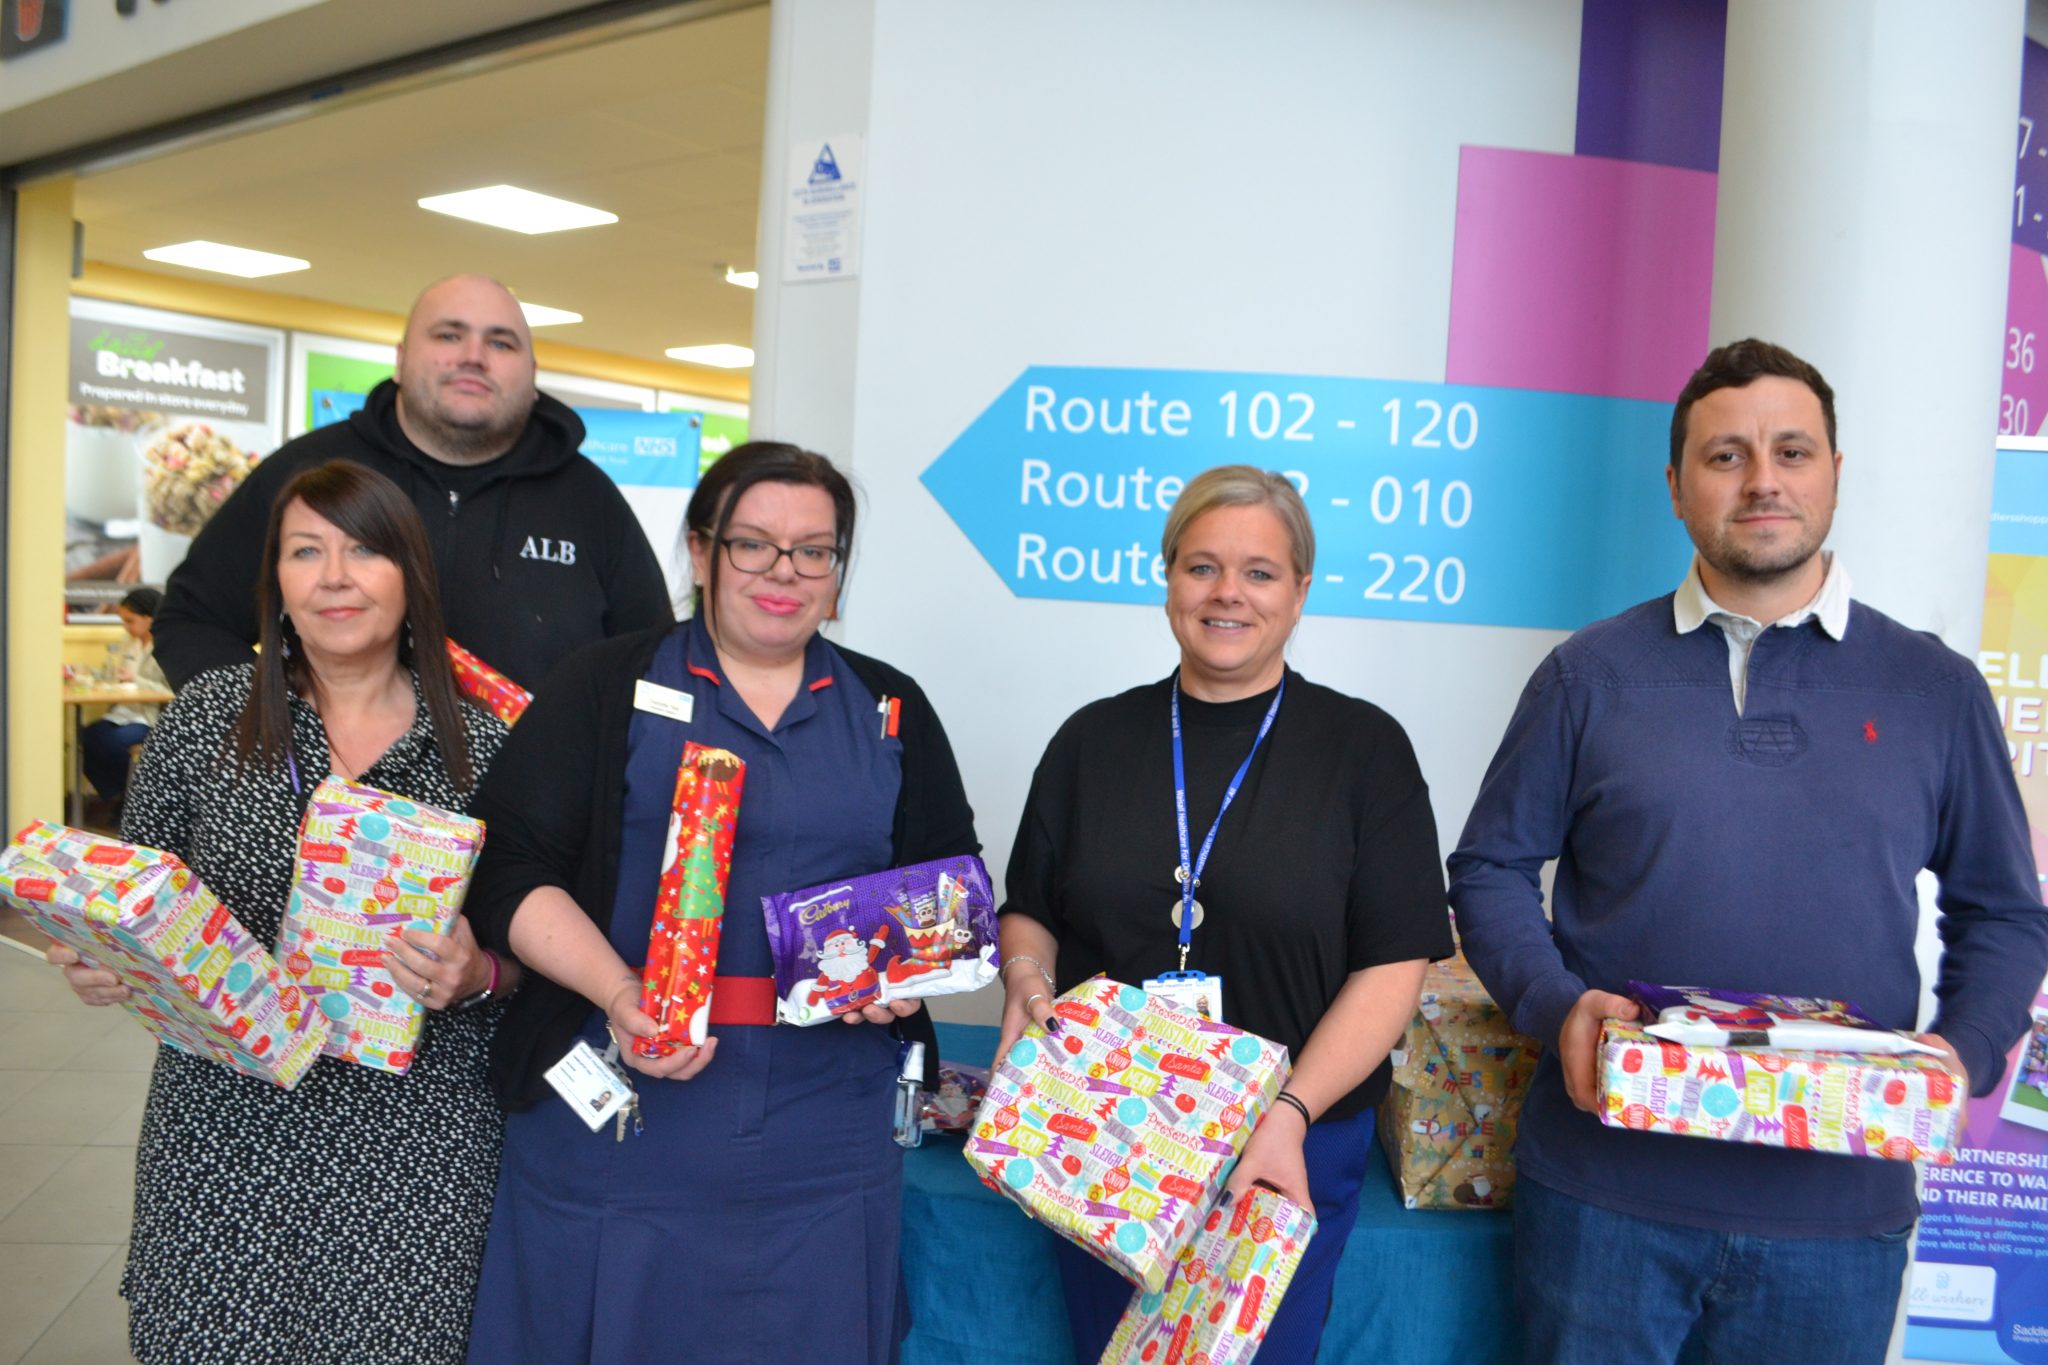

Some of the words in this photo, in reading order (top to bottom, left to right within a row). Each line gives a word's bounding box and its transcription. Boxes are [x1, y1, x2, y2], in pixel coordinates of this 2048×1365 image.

[2006, 327, 2036, 374] 36
[96, 350, 246, 394] Breakfast
[1025, 385, 1192, 436] Route
[1218, 390, 1315, 441] 102
[1382, 398, 1479, 450] 120
[1999, 394, 2029, 436] 30
[635, 437, 676, 457] NHS
[1020, 459, 1184, 511] Route
[1369, 475, 1473, 529] 010
[519, 535, 576, 565] ALB
[1363, 552, 1467, 605] 220
[1174, 789, 1185, 811] Walsall
[389, 822, 456, 851] Presents
[1176, 812, 1189, 848] Healthcare
[394, 838, 470, 873] CHRISTMAS
[1180, 848, 1189, 860] For
[374, 884, 398, 900] SNOW
[151, 888, 218, 959] CHRISTMAS
[299, 898, 366, 926] Presents
[799, 898, 850, 926] Cadbury
[306, 914, 383, 947] CHRISTMAS
[197, 947, 234, 986] MERRY
[252, 989, 281, 1025] SLEIGH
[279, 987, 299, 1010] SNOW
[1058, 1000, 1093, 1026] Santa
[1145, 996, 1199, 1031] Presents
[1091, 1025, 1125, 1050] SLEIGH
[1142, 1013, 1208, 1054] CHRISTMAS
[1032, 1052, 1090, 1092] Presents
[1106, 1051, 1130, 1070] SNOW
[1164, 1051, 1205, 1082] Santa
[1217, 1058, 1251, 1083] NOEL
[1029, 1070, 1098, 1116] CHRISTMAS
[1123, 1068, 1158, 1096] MERRY
[1203, 1080, 1238, 1106] SLEIGH
[1647, 1075, 1668, 1115] SLEIGH
[994, 1109, 1017, 1128] SNOW
[1054, 1114, 1091, 1141] Santa
[1142, 1109, 1205, 1152] Presents
[1219, 1108, 1245, 1129] SNOW
[1629, 1105, 1645, 1129] SNOW
[1011, 1127, 1045, 1155] MERRY
[1088, 1142, 1123, 1168] SLEIGH
[1140, 1130, 1213, 1177] CHRISTMAS
[1028, 1171, 1090, 1214] Presents
[1103, 1169, 1130, 1191] SNOW
[1989, 1171, 2013, 1187] TO
[2018, 1174, 2048, 1189] WA
[1123, 1189, 1156, 1216] MERRY
[1945, 1189, 1999, 1207] THEIR
[1943, 1227, 1981, 1240] making
[1992, 1230, 2045, 1243] difference
[1954, 1214, 1992, 1226] Walsall
[1994, 1217, 2029, 1229] Manor
[1204, 1235, 1226, 1272] SLEIGH
[1941, 1240, 1966, 1251] what
[1968, 1241, 1986, 1252] the
[1988, 1243, 2012, 1254] NHS
[2014, 1246, 2033, 1256] can
[1186, 1258, 1204, 1283] SNOW
[1236, 1282, 1264, 1327] Santa
[1165, 1321, 1190, 1363] Santa
